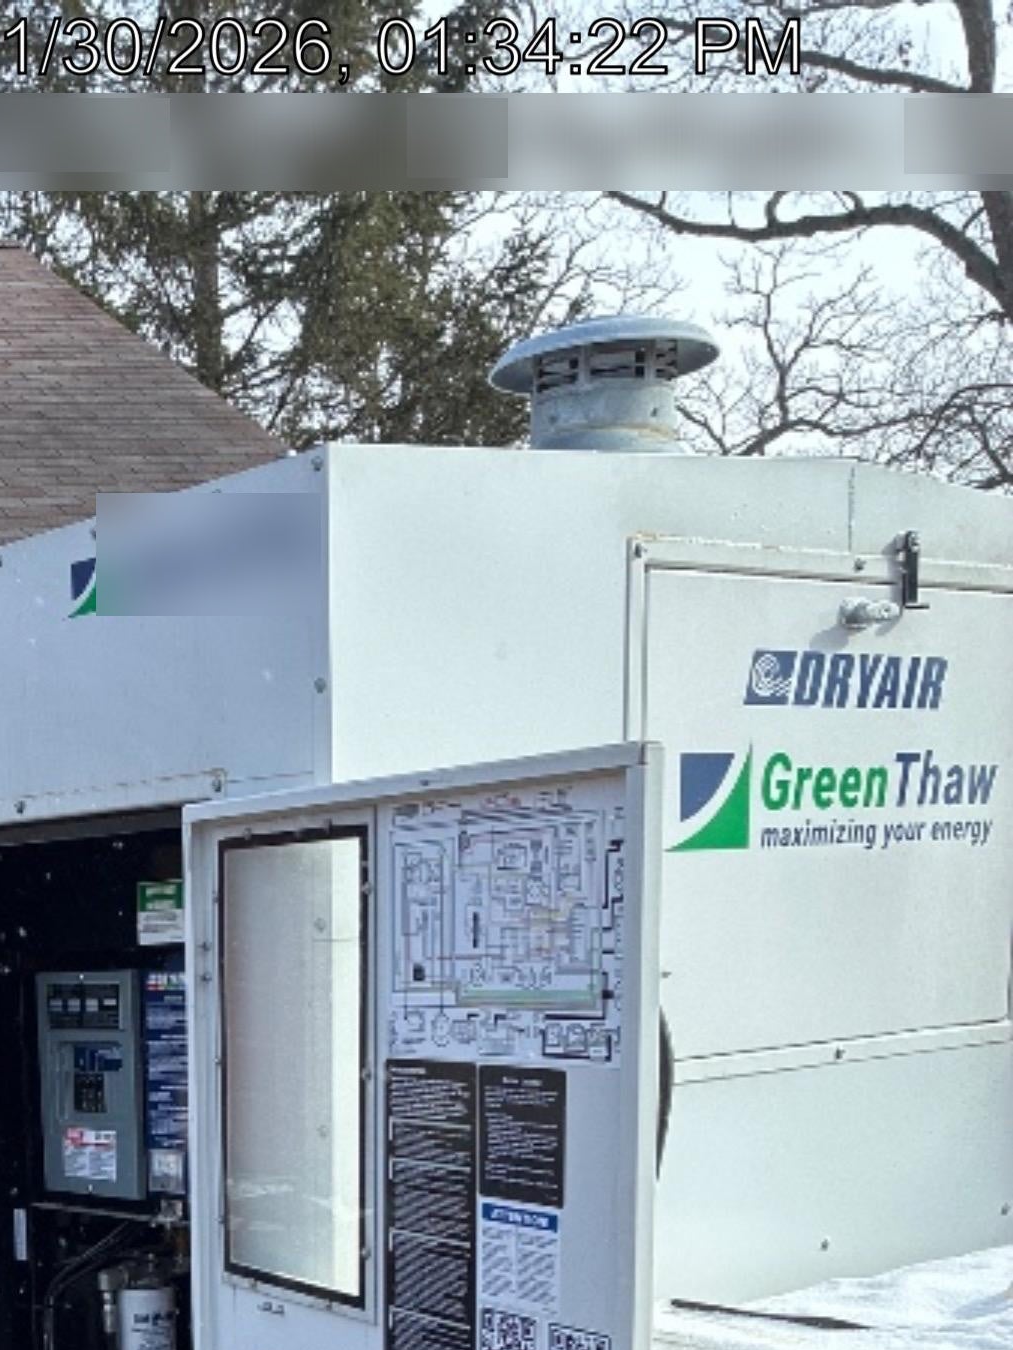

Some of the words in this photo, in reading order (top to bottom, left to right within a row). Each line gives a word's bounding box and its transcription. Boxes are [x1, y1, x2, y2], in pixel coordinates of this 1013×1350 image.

[791, 650, 948, 710] DRYAIR
[760, 749, 998, 811] GreenThaw
[760, 818, 877, 850] maximizing
[882, 823, 926, 849] your
[931, 819, 993, 846] energy
